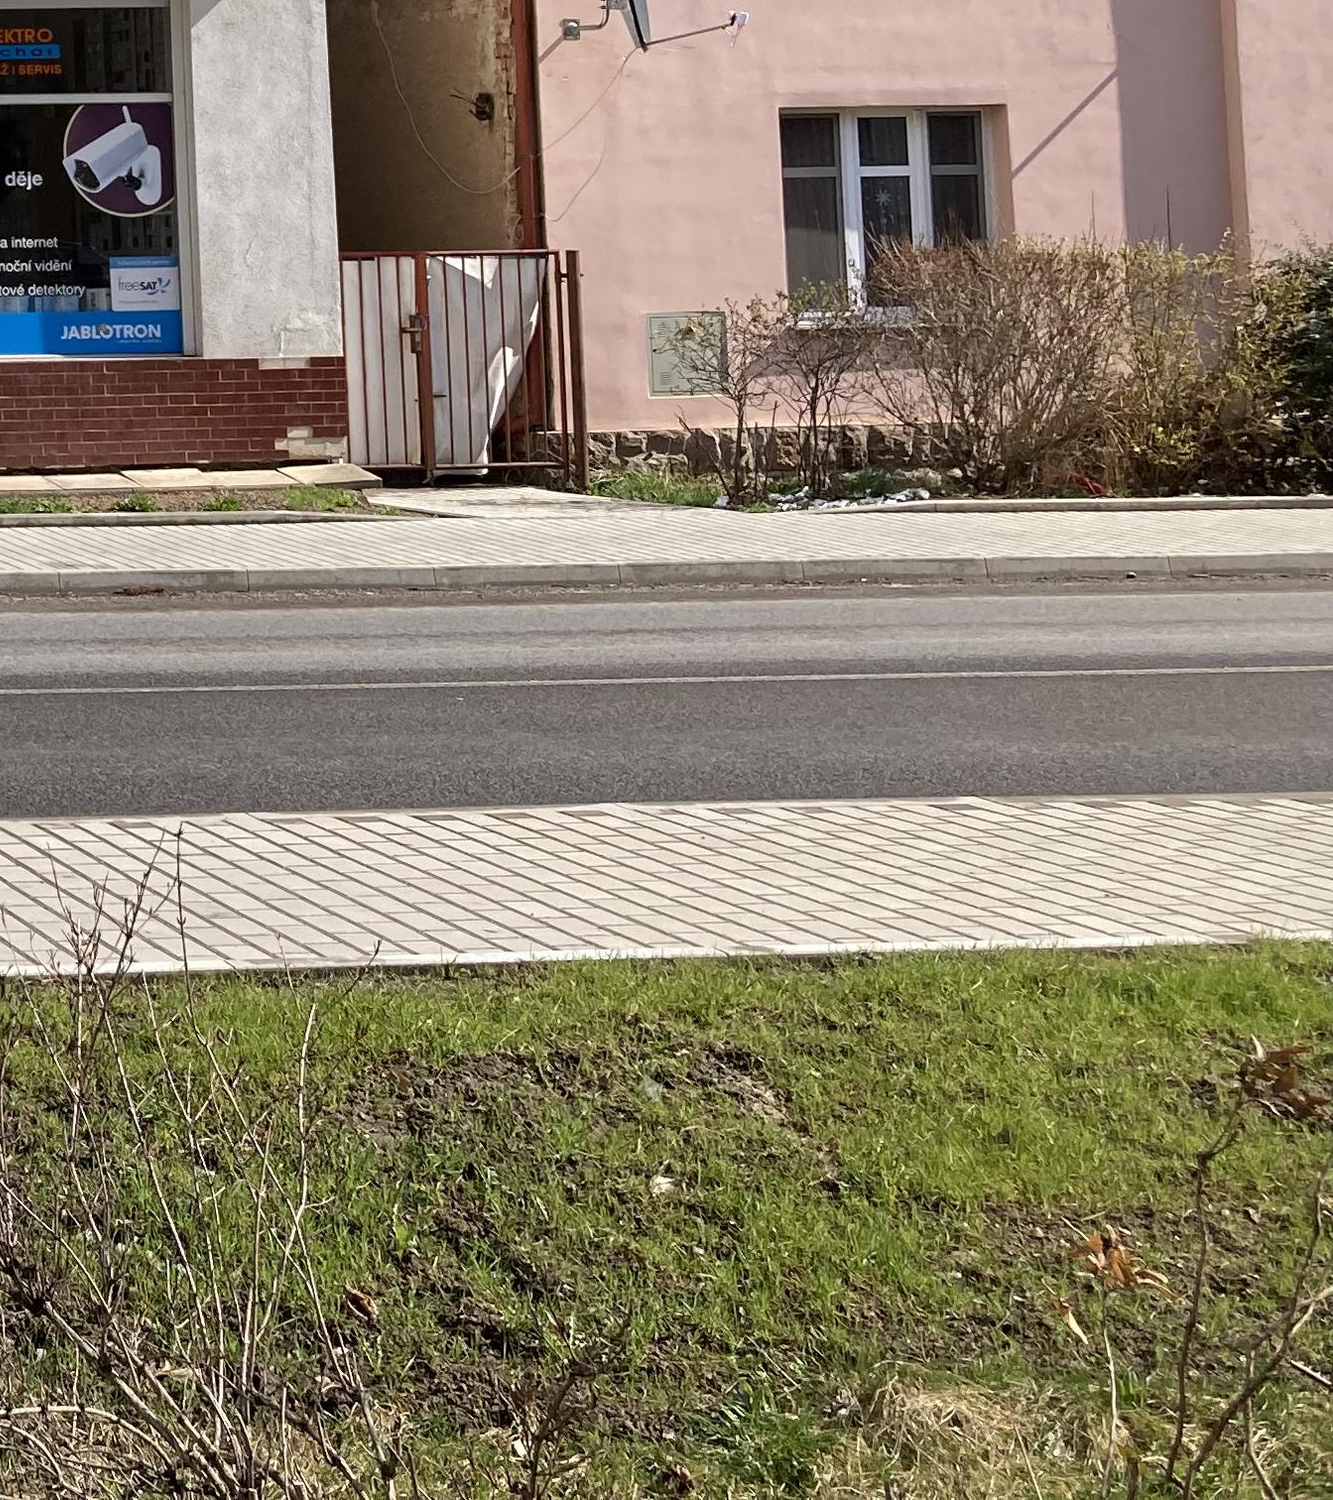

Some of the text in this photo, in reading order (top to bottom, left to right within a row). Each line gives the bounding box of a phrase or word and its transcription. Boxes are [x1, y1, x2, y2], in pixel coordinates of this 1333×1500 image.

[18, 64, 62, 75] SERVIS
[4, 171, 44, 191] děje
[0, 239, 8, 249] a
[11, 236, 58, 249] internet
[34, 259, 72, 272] vidění
[28, 283, 86, 299] detektory
[60, 323, 161, 340] JABLOTRON
